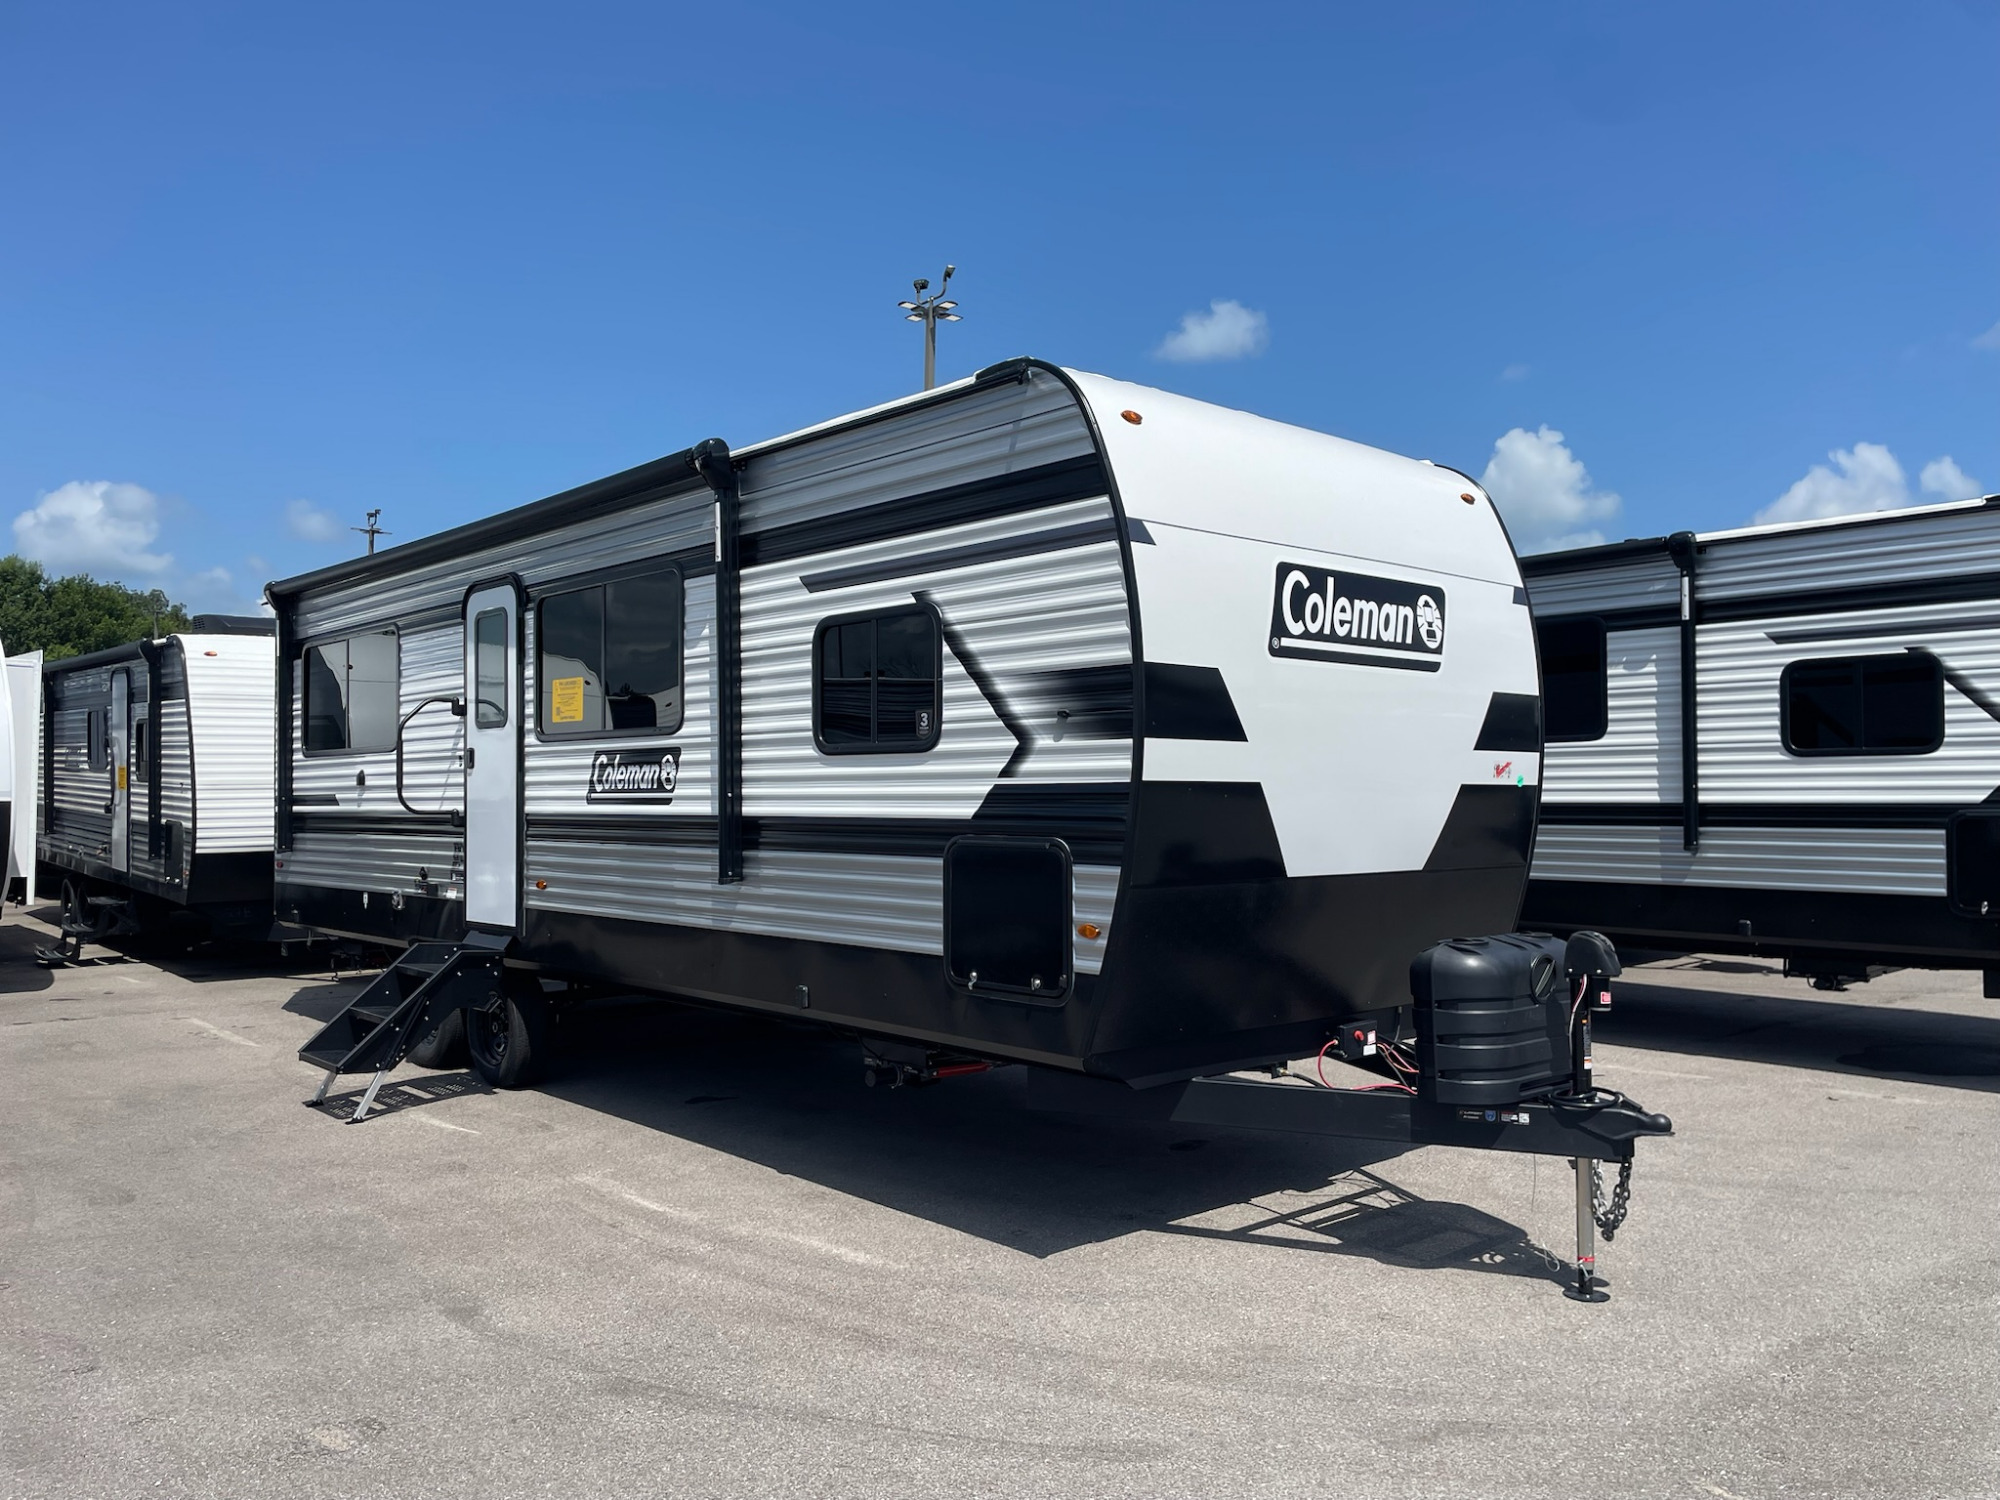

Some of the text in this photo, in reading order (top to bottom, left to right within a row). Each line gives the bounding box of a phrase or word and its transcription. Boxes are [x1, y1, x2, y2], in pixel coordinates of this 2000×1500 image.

[1282, 569, 1414, 645] Coleman
[920, 712, 929, 727] 3
[593, 754, 660, 793] Coleman
